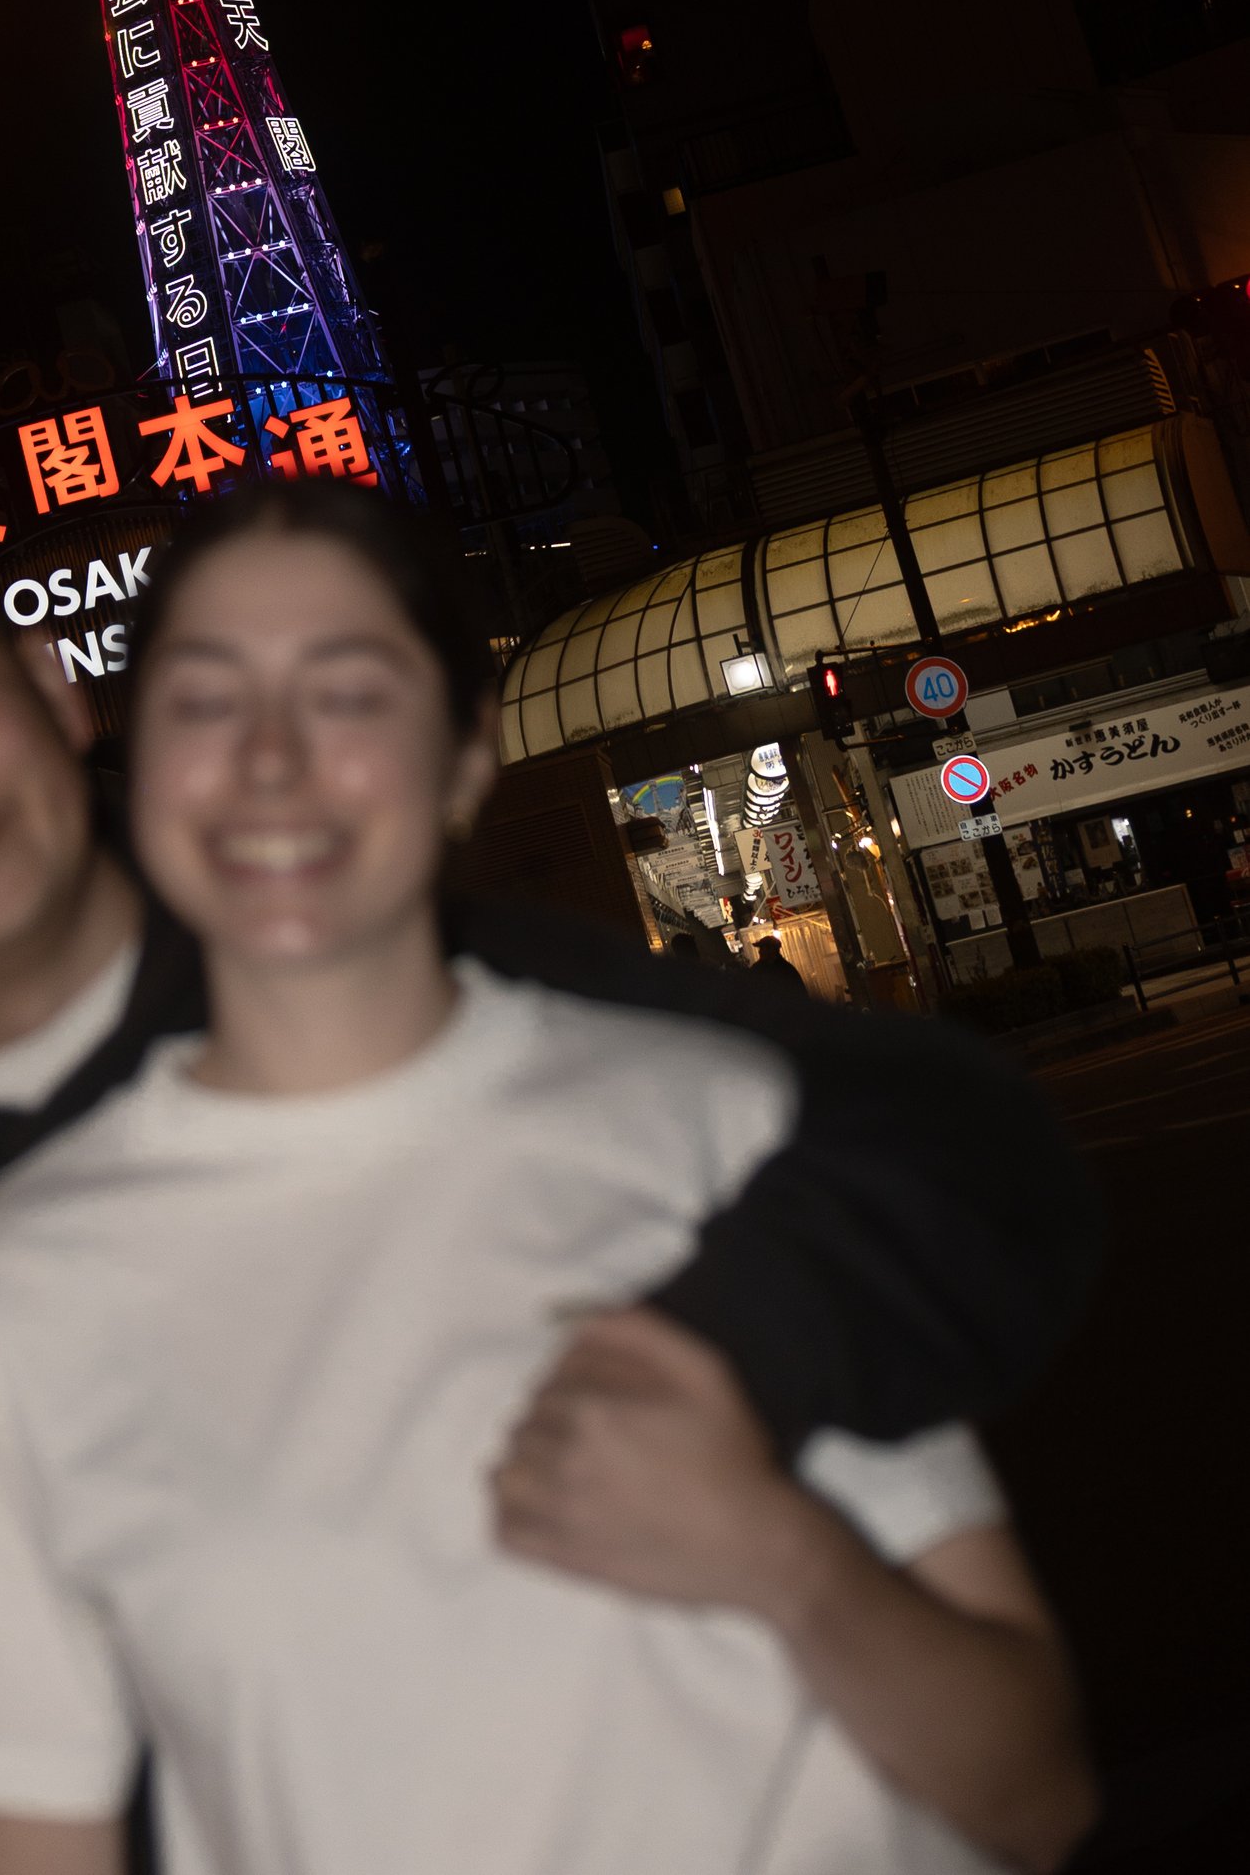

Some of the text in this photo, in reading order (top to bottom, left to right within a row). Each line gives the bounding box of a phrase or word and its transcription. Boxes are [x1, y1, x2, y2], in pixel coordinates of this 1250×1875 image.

[3, 545, 152, 627] OSAK
[923, 674, 955, 702] 40
[936, 737, 974, 756] ここから
[1050, 734, 1180, 780] かすうどん
[989, 763, 1039, 802] 大阪名物
[960, 815, 998, 829] 自動車
[963, 824, 1001, 840] ここから
[774, 832, 802, 883] ワイン
